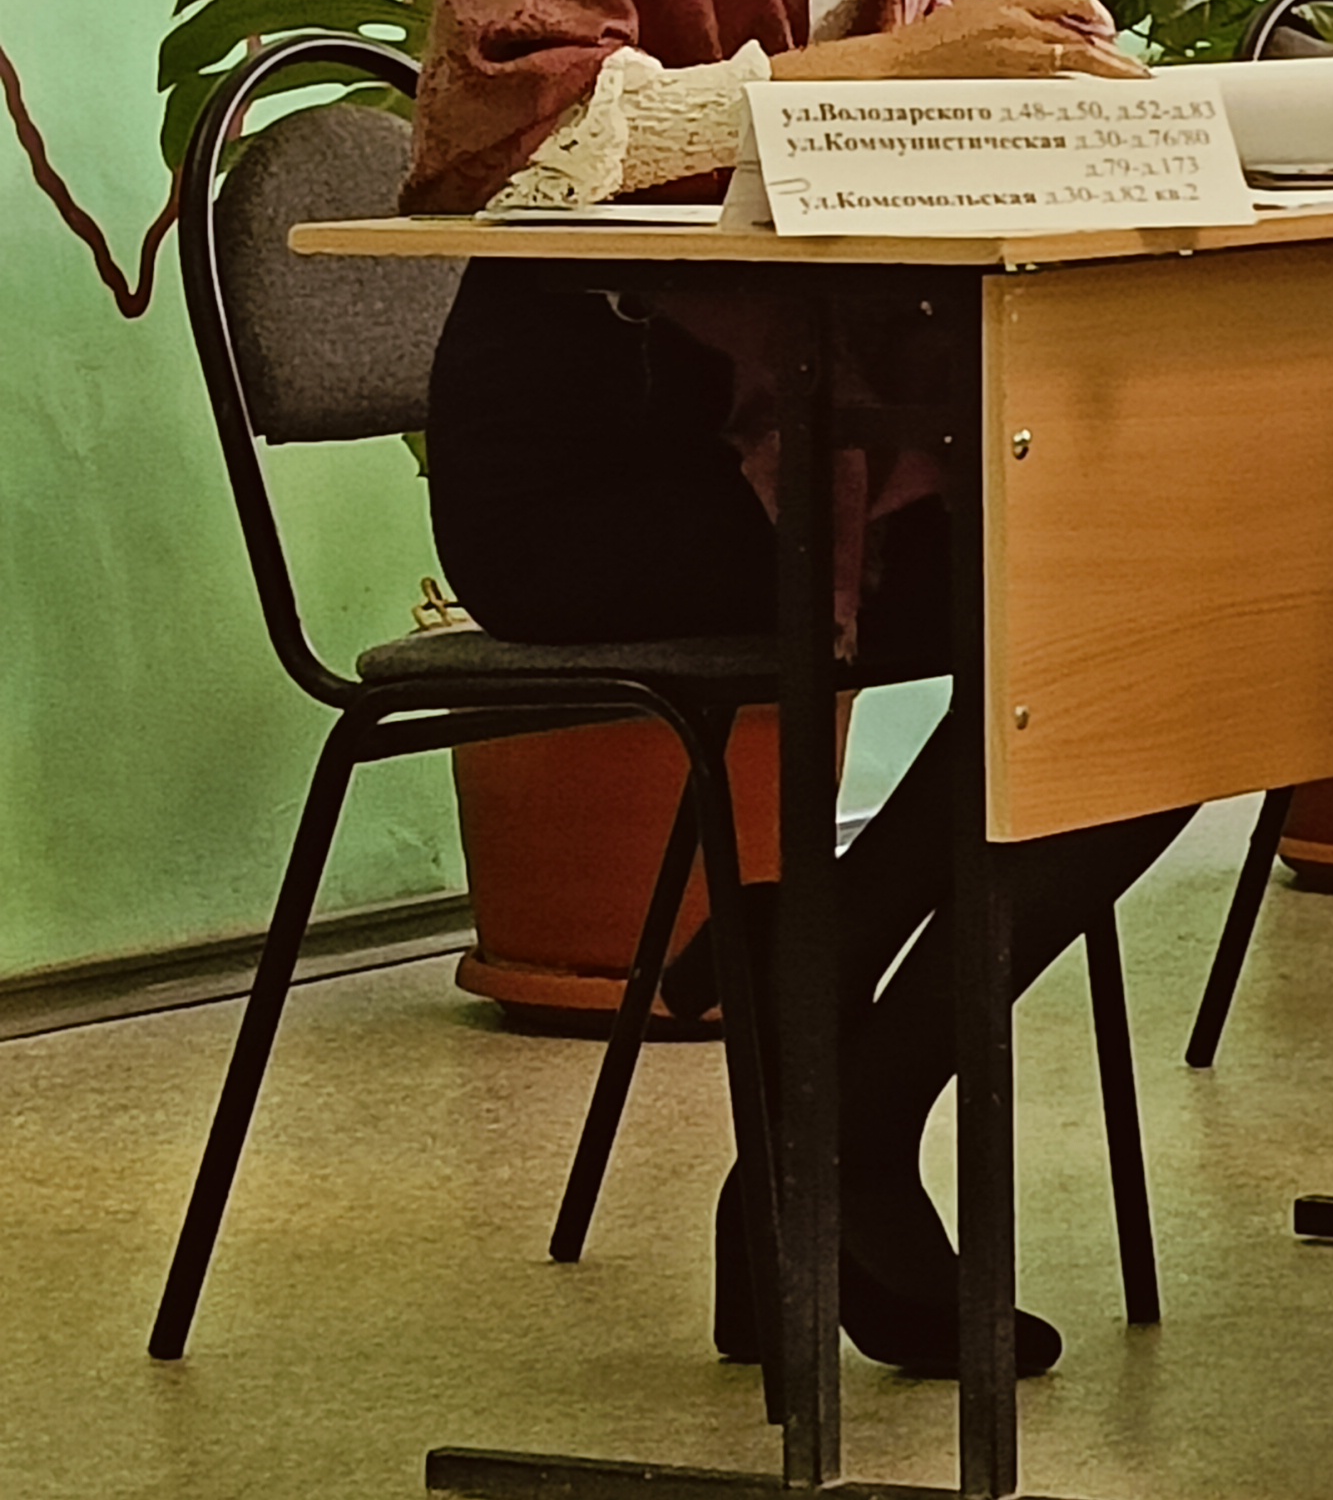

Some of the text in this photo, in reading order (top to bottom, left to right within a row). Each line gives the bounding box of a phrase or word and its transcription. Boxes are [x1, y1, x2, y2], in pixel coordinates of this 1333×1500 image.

[781, 103, 992, 128] ул.Володарского
[786, 132, 1067, 158] ул.Коммунистическая
[799, 191, 1037, 215] ул.Комсомольская
